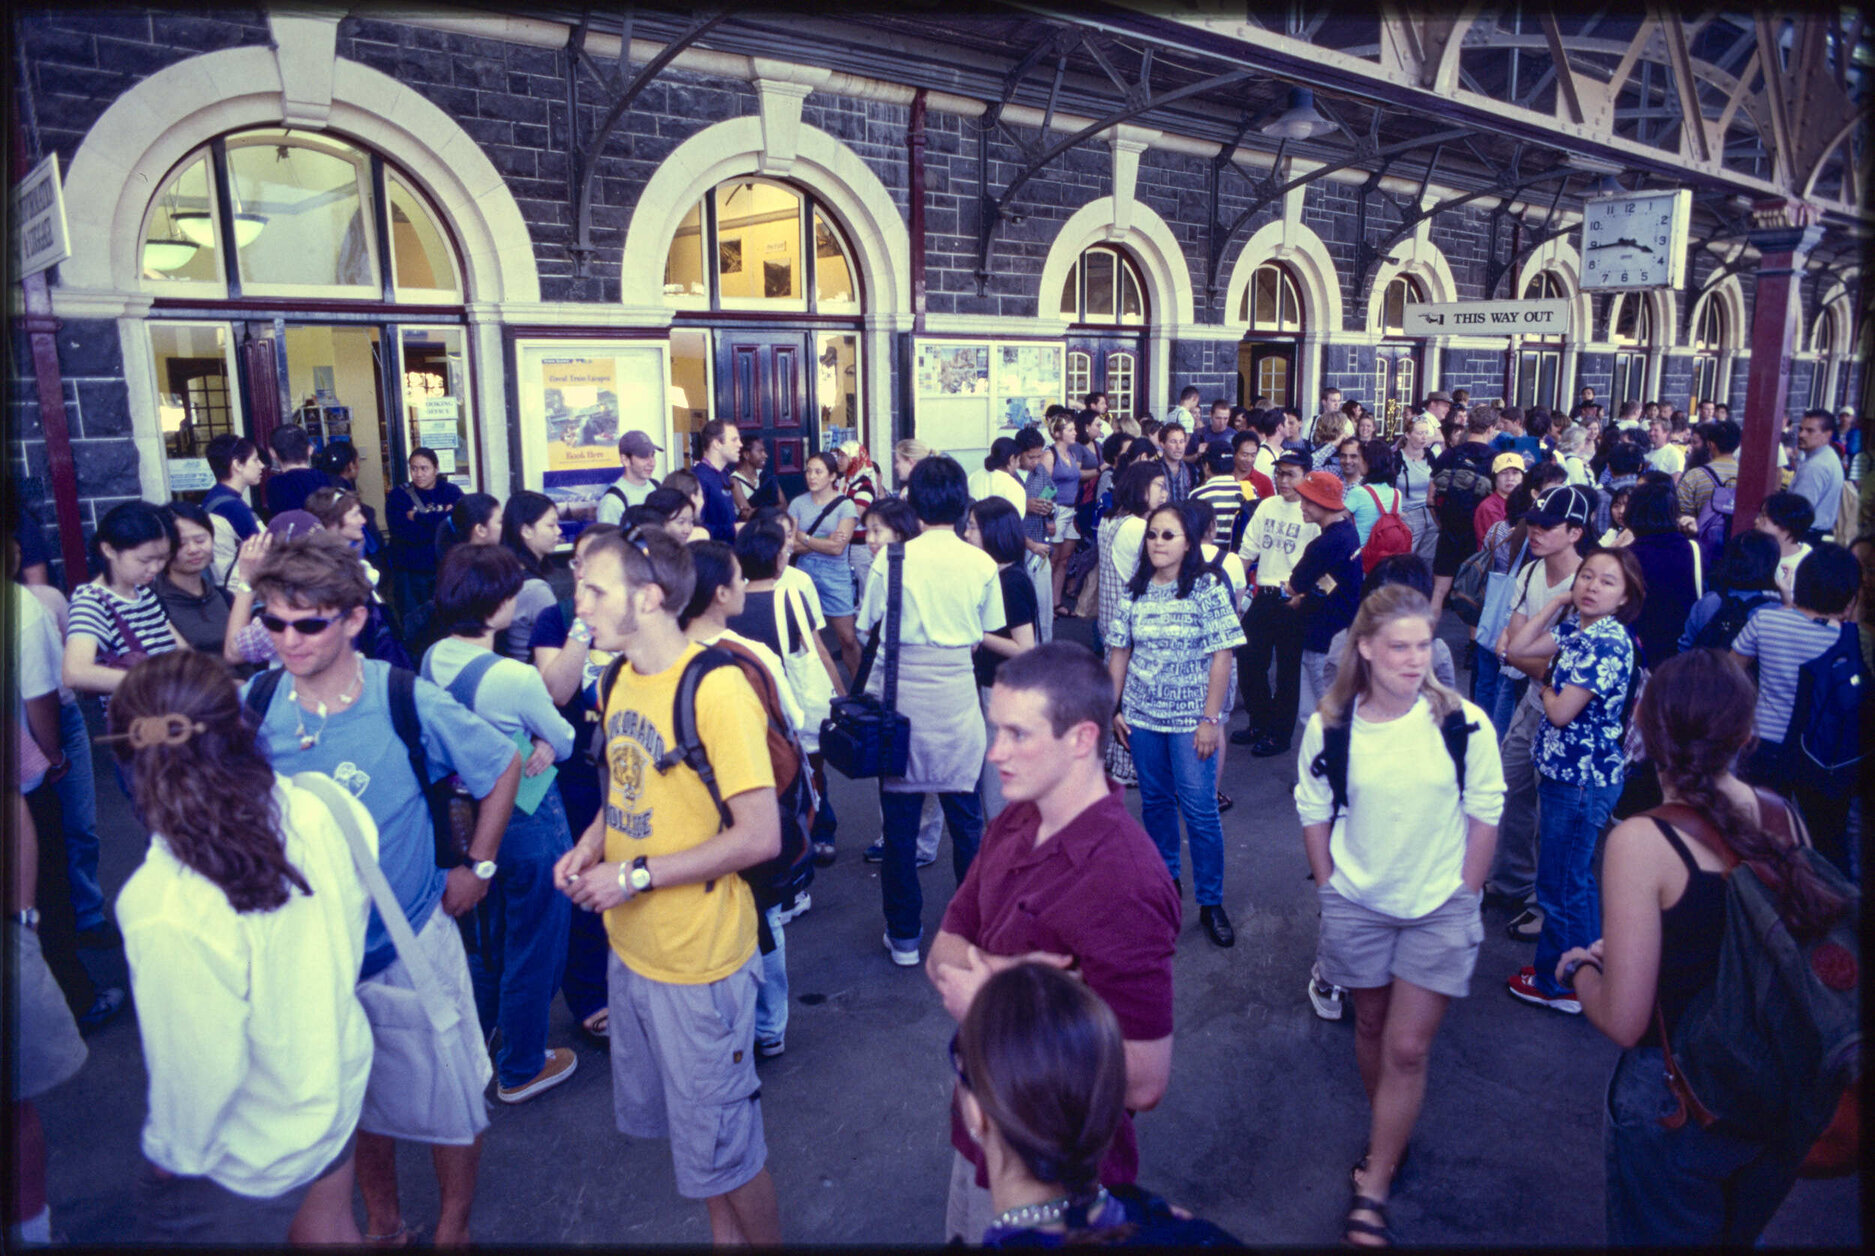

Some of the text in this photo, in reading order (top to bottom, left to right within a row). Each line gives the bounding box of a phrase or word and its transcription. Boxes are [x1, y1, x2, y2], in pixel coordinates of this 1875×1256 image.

[1606, 205, 1615, 215] 11
[1624, 202, 1636, 214] 12
[1648, 201, 1653, 211] 1
[1661, 215, 1669, 225] 2
[1590, 220, 1601, 231] 10
[1590, 241, 1598, 250] 9
[1659, 236, 1667, 246] 3
[1588, 260, 1596, 270] 8
[1657, 257, 1665, 266] 4
[1602, 273, 1609, 283] 7
[1621, 272, 1629, 282] 6
[1641, 271, 1649, 281] 5
[1453, 311, 1554, 324] THIS WAY OUT
